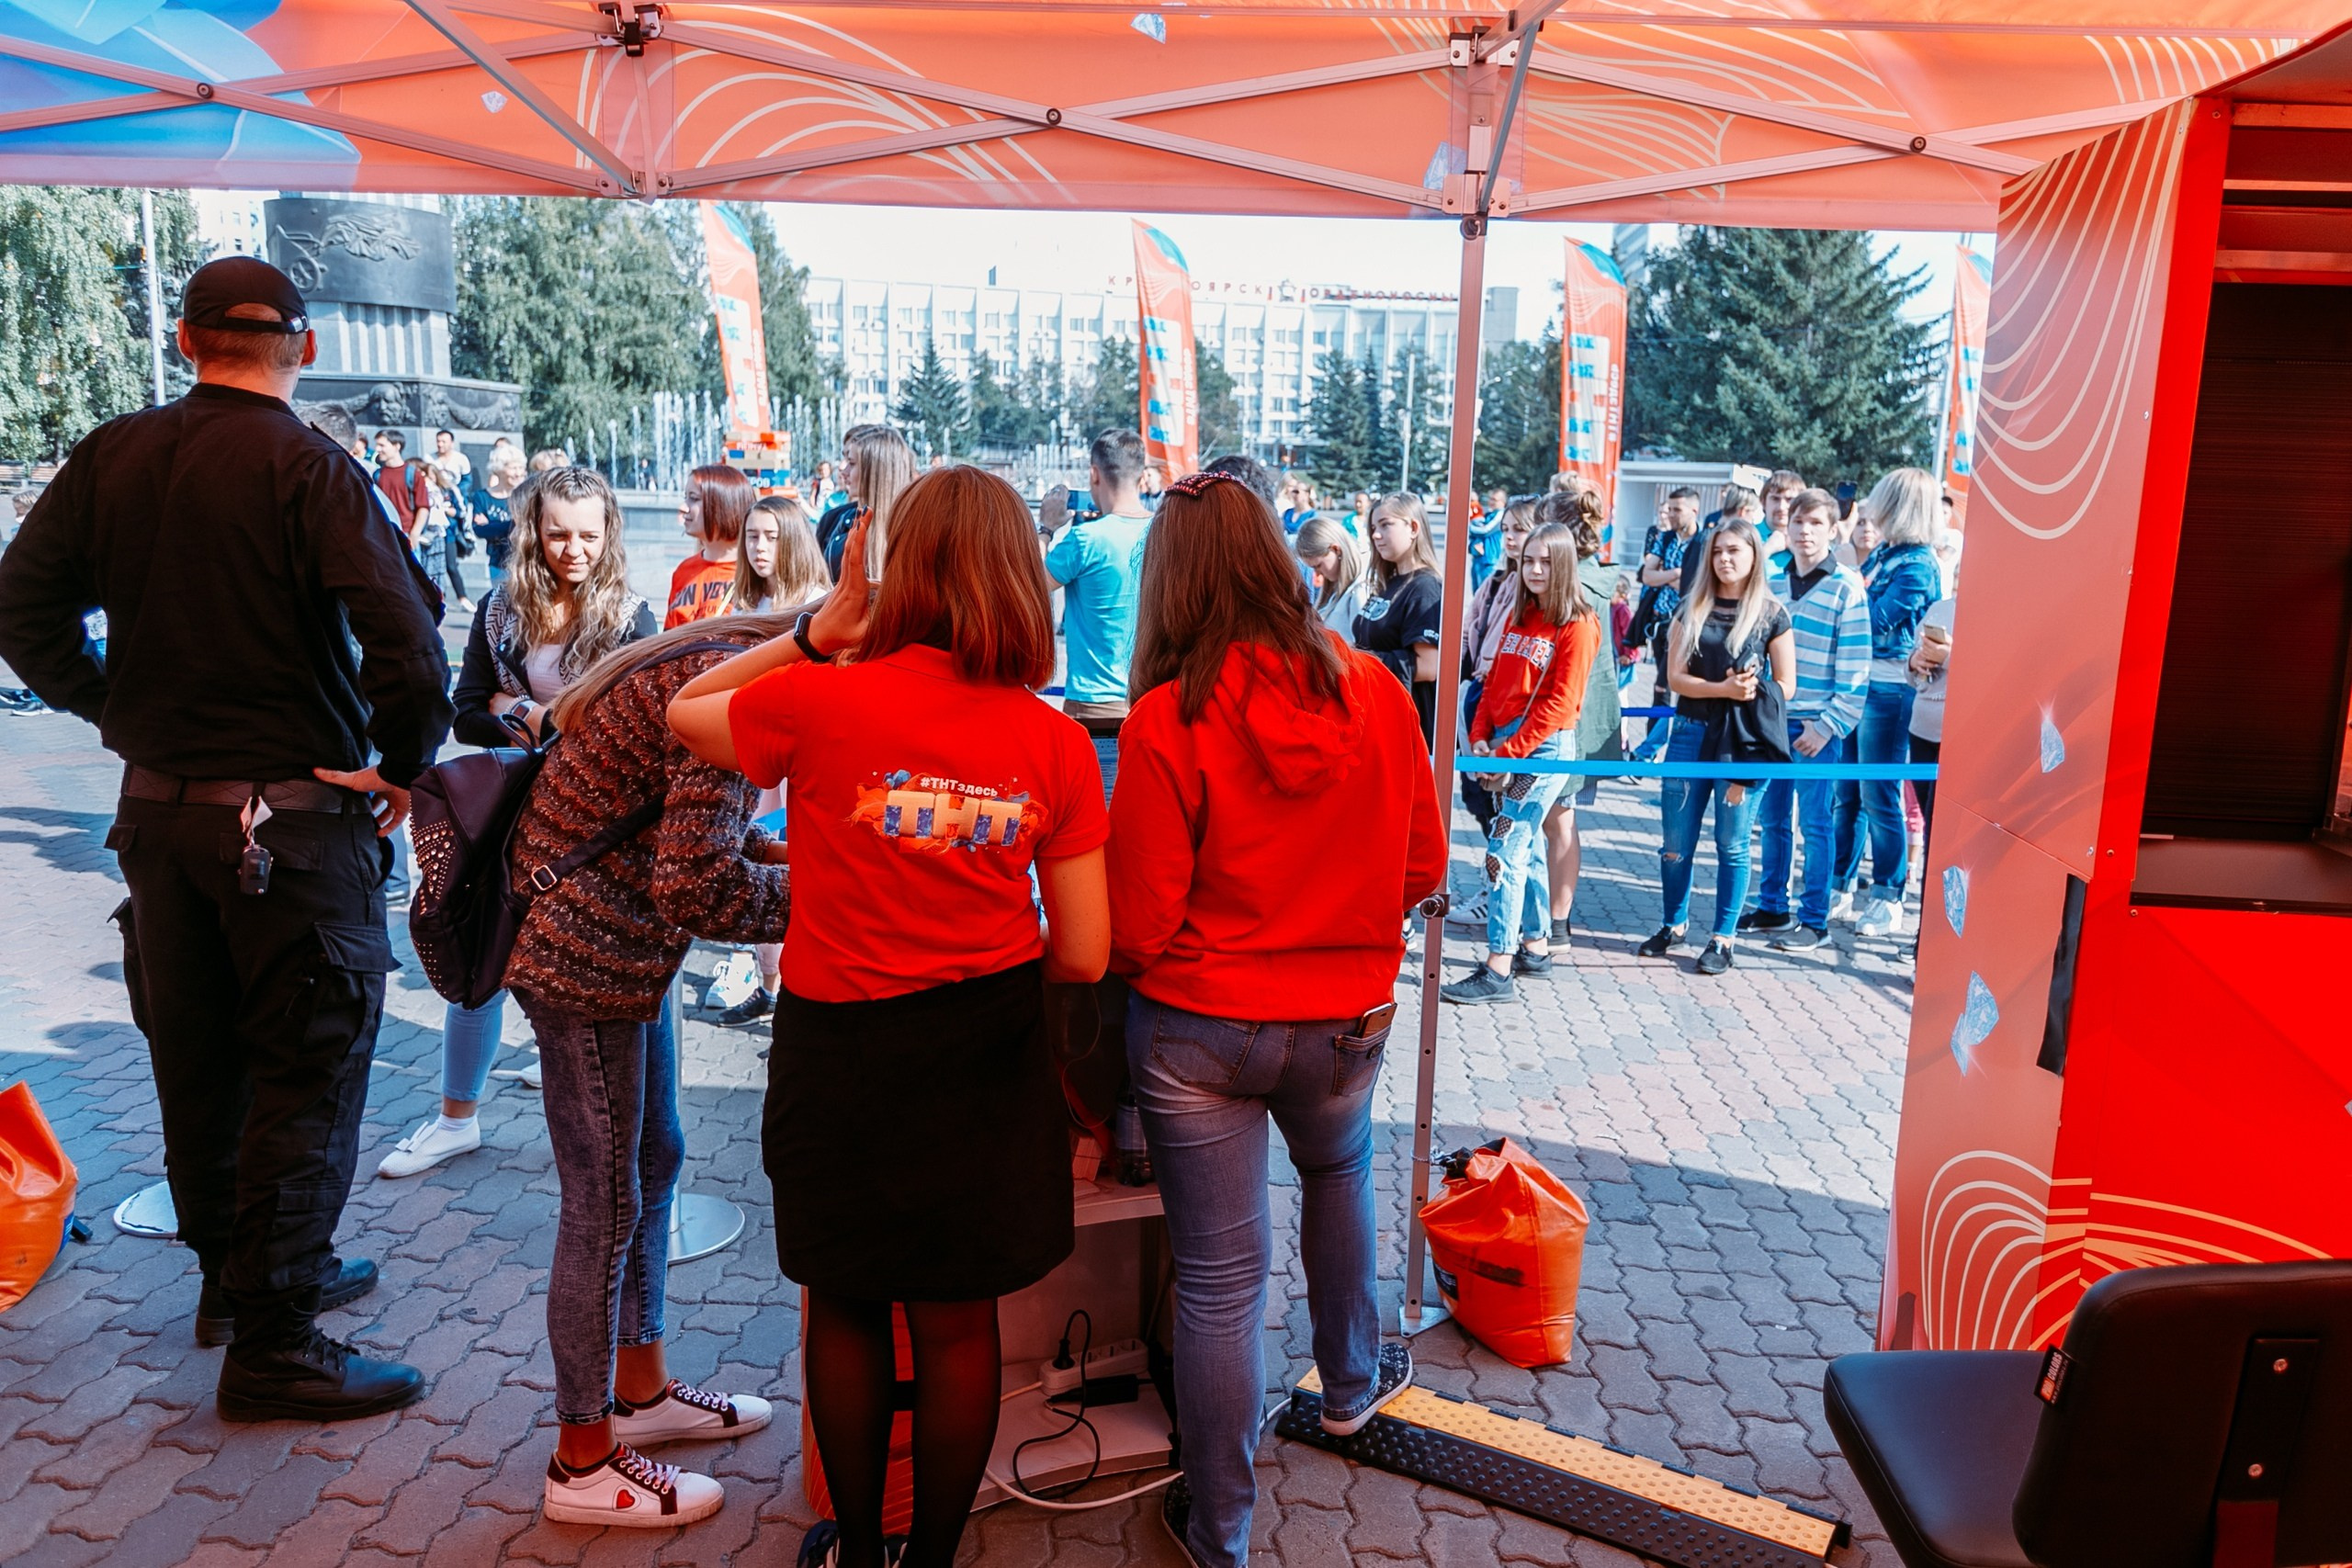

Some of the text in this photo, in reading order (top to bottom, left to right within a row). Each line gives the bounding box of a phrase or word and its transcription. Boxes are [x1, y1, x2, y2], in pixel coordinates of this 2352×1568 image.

[1108, 276, 1262, 295] КРОЯРСК
[920, 776, 999, 797] #ТНТздесь
[884, 790, 1023, 846] ТНТ
[2047, 1351, 2063, 1382] COLORS
